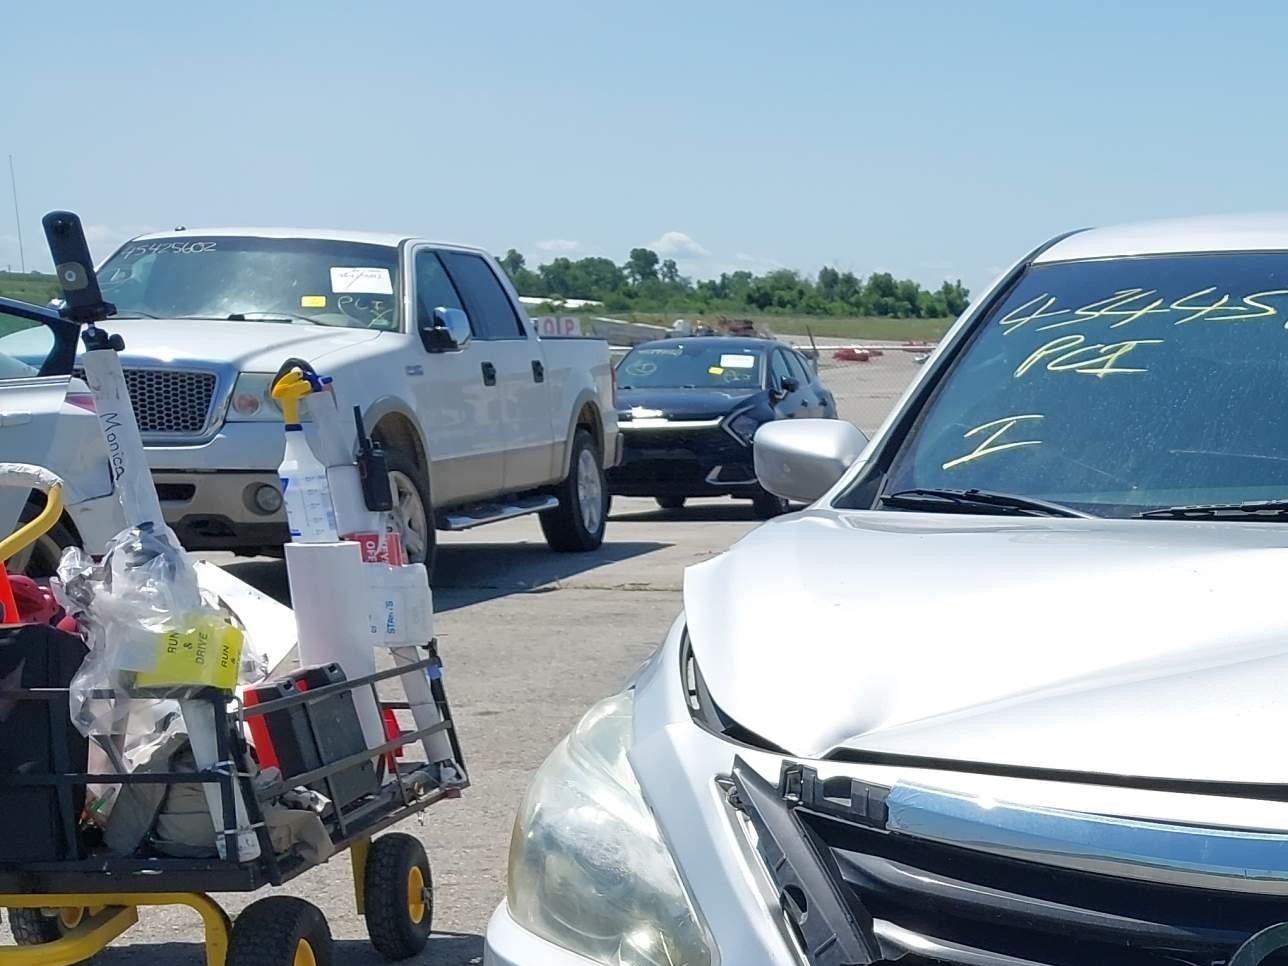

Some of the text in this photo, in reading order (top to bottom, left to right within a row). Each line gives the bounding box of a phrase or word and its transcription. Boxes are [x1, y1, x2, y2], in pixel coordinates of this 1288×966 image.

[99, 412, 125, 481] Monica
[167, 632, 179, 654] RUN
[183, 642, 193, 650] &
[195, 632, 208, 665] DRIVE
[220, 645, 230, 668] RUN
